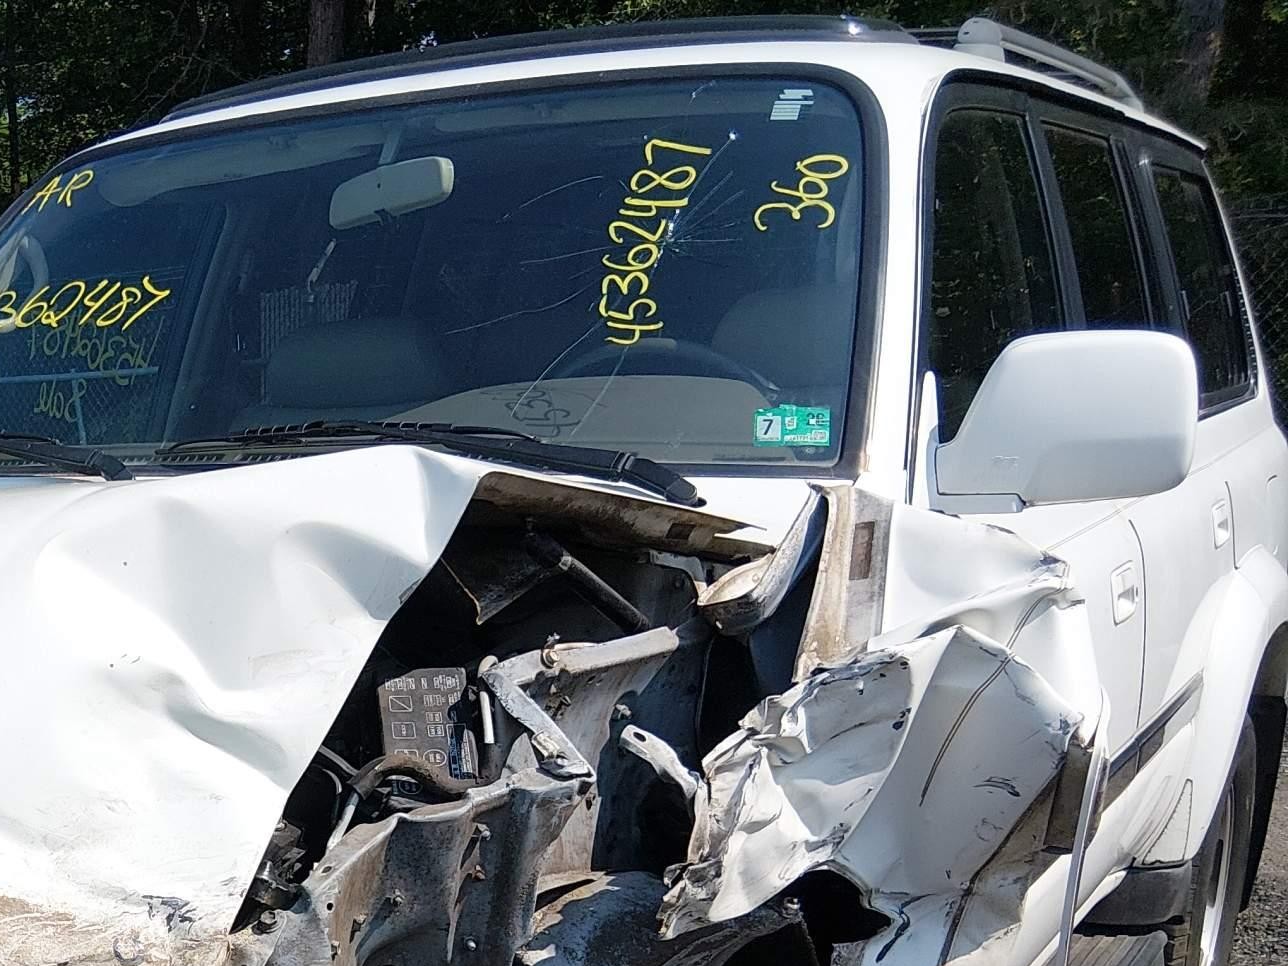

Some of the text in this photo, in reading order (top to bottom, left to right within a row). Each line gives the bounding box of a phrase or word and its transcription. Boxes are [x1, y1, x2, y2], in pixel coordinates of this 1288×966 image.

[754, 153, 850, 232] 360
[599, 138, 712, 346] 45362487
[763, 418, 774, 436] 7
